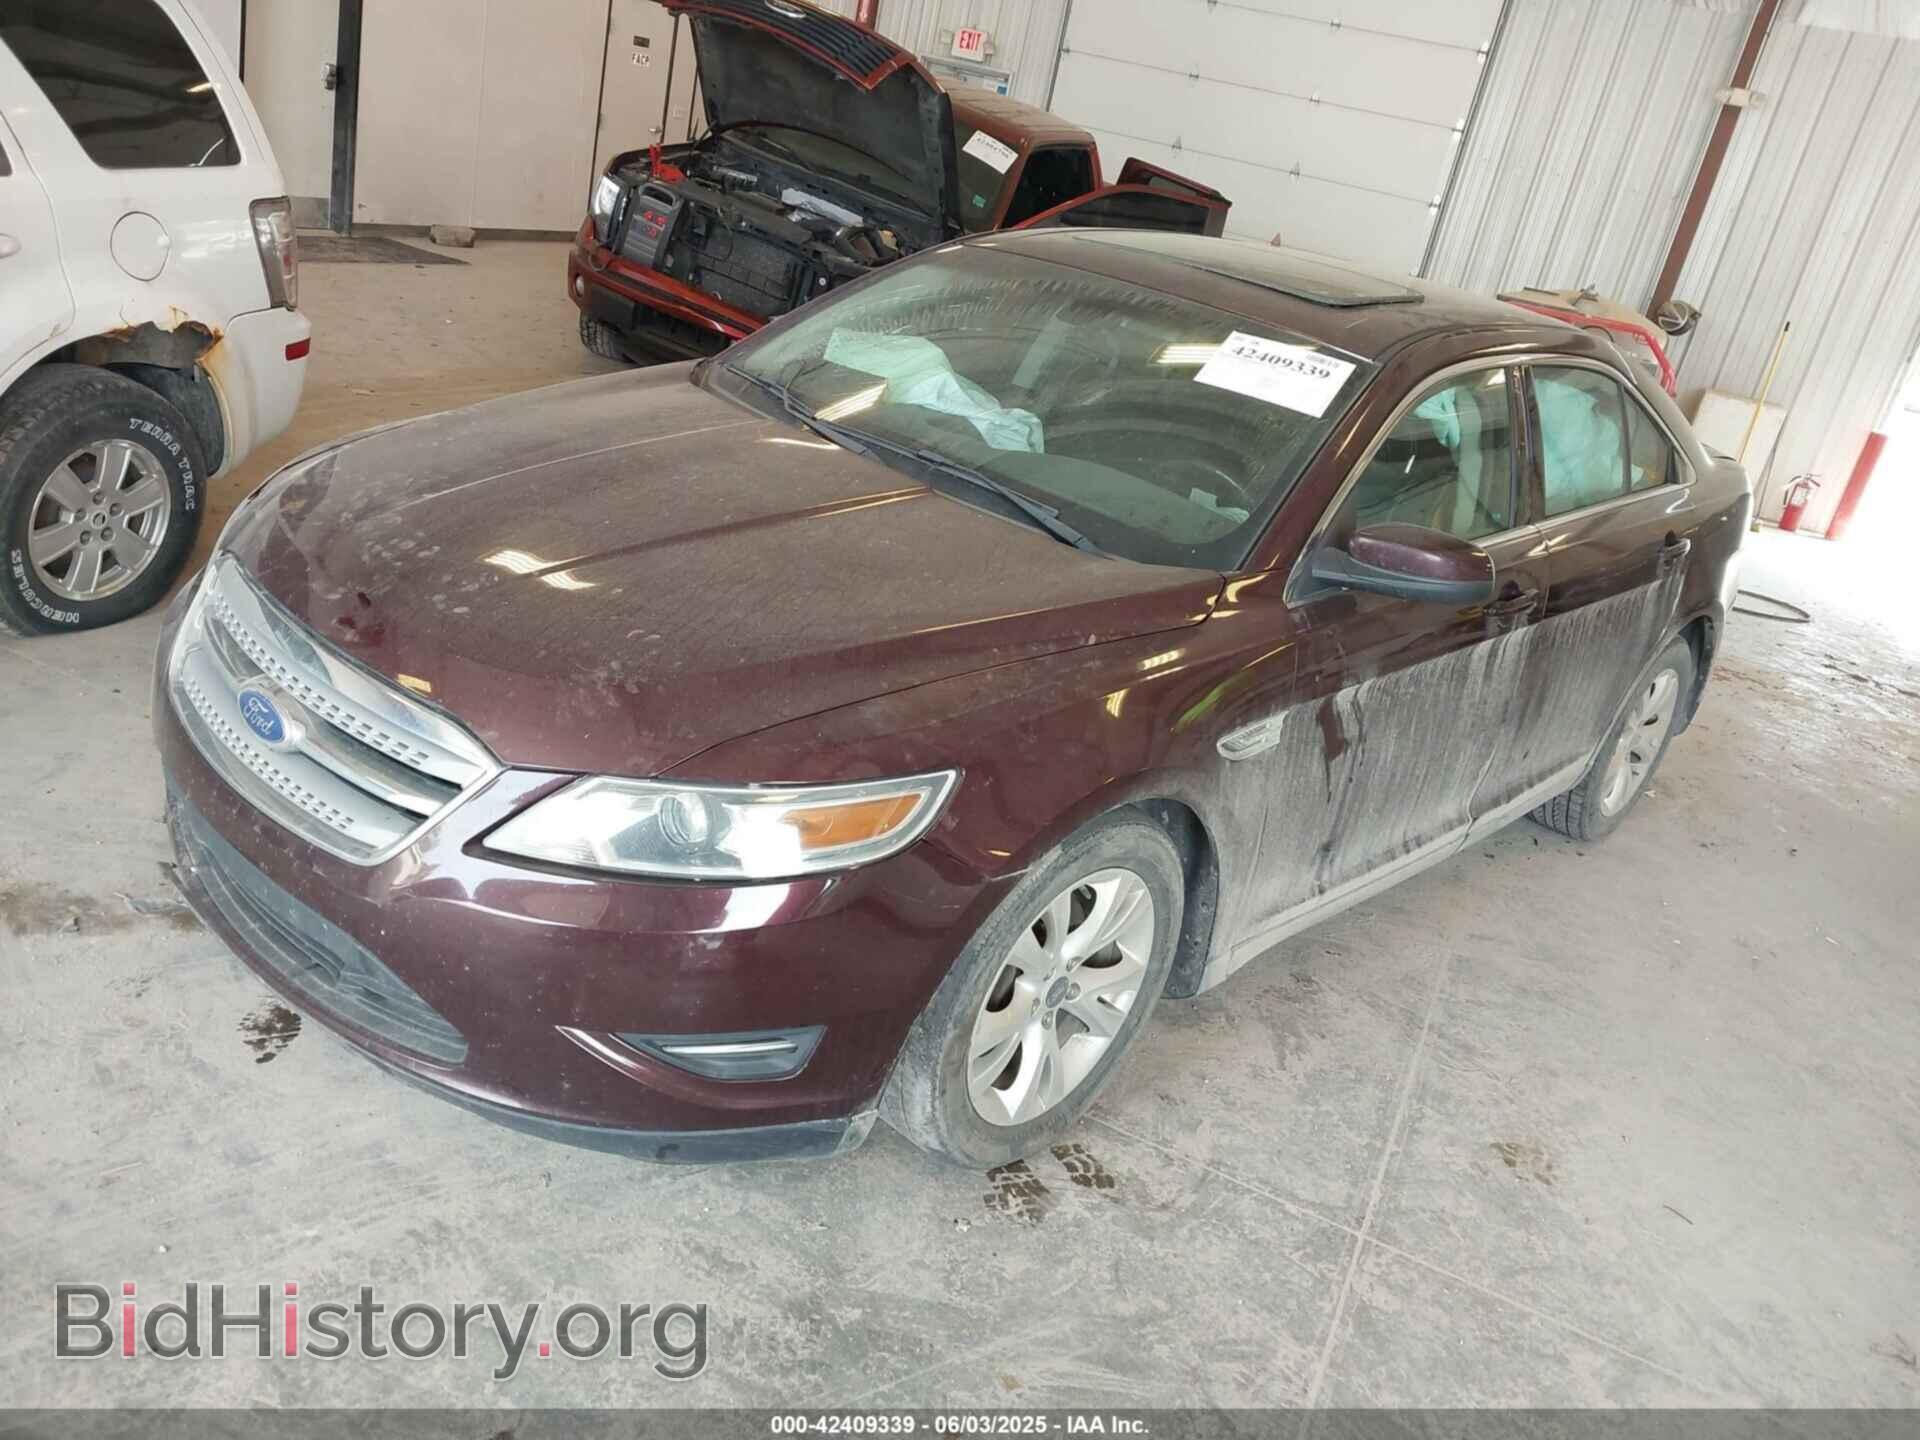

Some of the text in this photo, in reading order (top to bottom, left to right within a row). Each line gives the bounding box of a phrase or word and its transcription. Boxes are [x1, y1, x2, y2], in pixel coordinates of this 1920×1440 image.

[960, 30, 982, 51] EXIT
[1232, 346, 1331, 379] 42409339
[129, 417, 196, 510] TERRA TRAC
[11, 549, 80, 623] HERCULES
[243, 696, 275, 735] Ford
